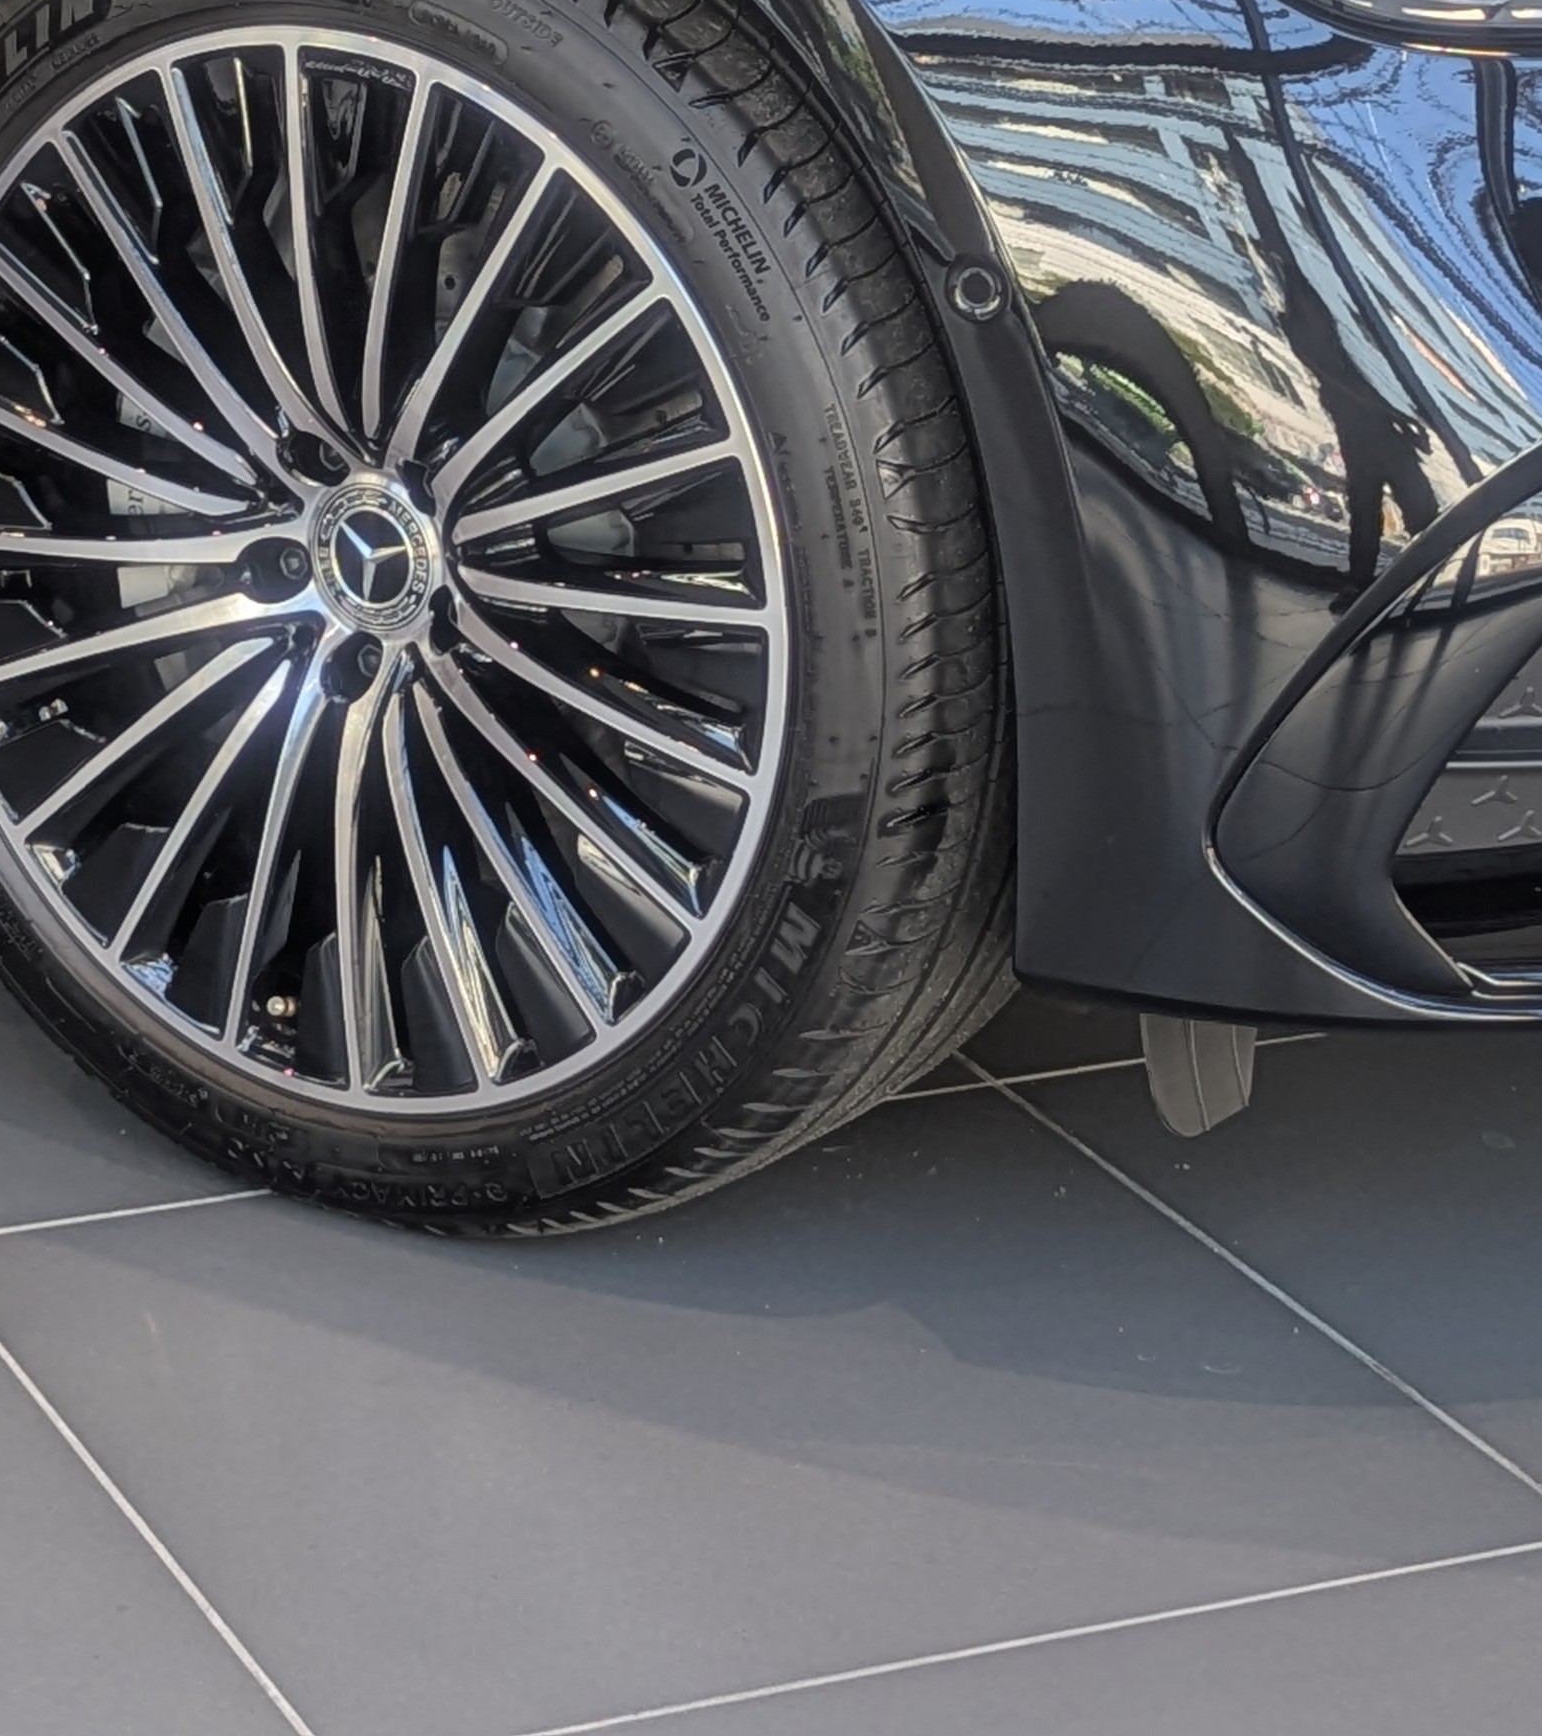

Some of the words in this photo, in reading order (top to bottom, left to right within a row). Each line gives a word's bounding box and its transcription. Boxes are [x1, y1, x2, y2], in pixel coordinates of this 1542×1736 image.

[690, 193, 720, 229] Total
[713, 229, 771, 322] Performance
[704, 183, 771, 278] MICHELIN
[823, 403, 857, 490] TREADWEAR
[387, 500, 428, 595] MERCEDES
[556, 901, 822, 1183] MICHELIN
